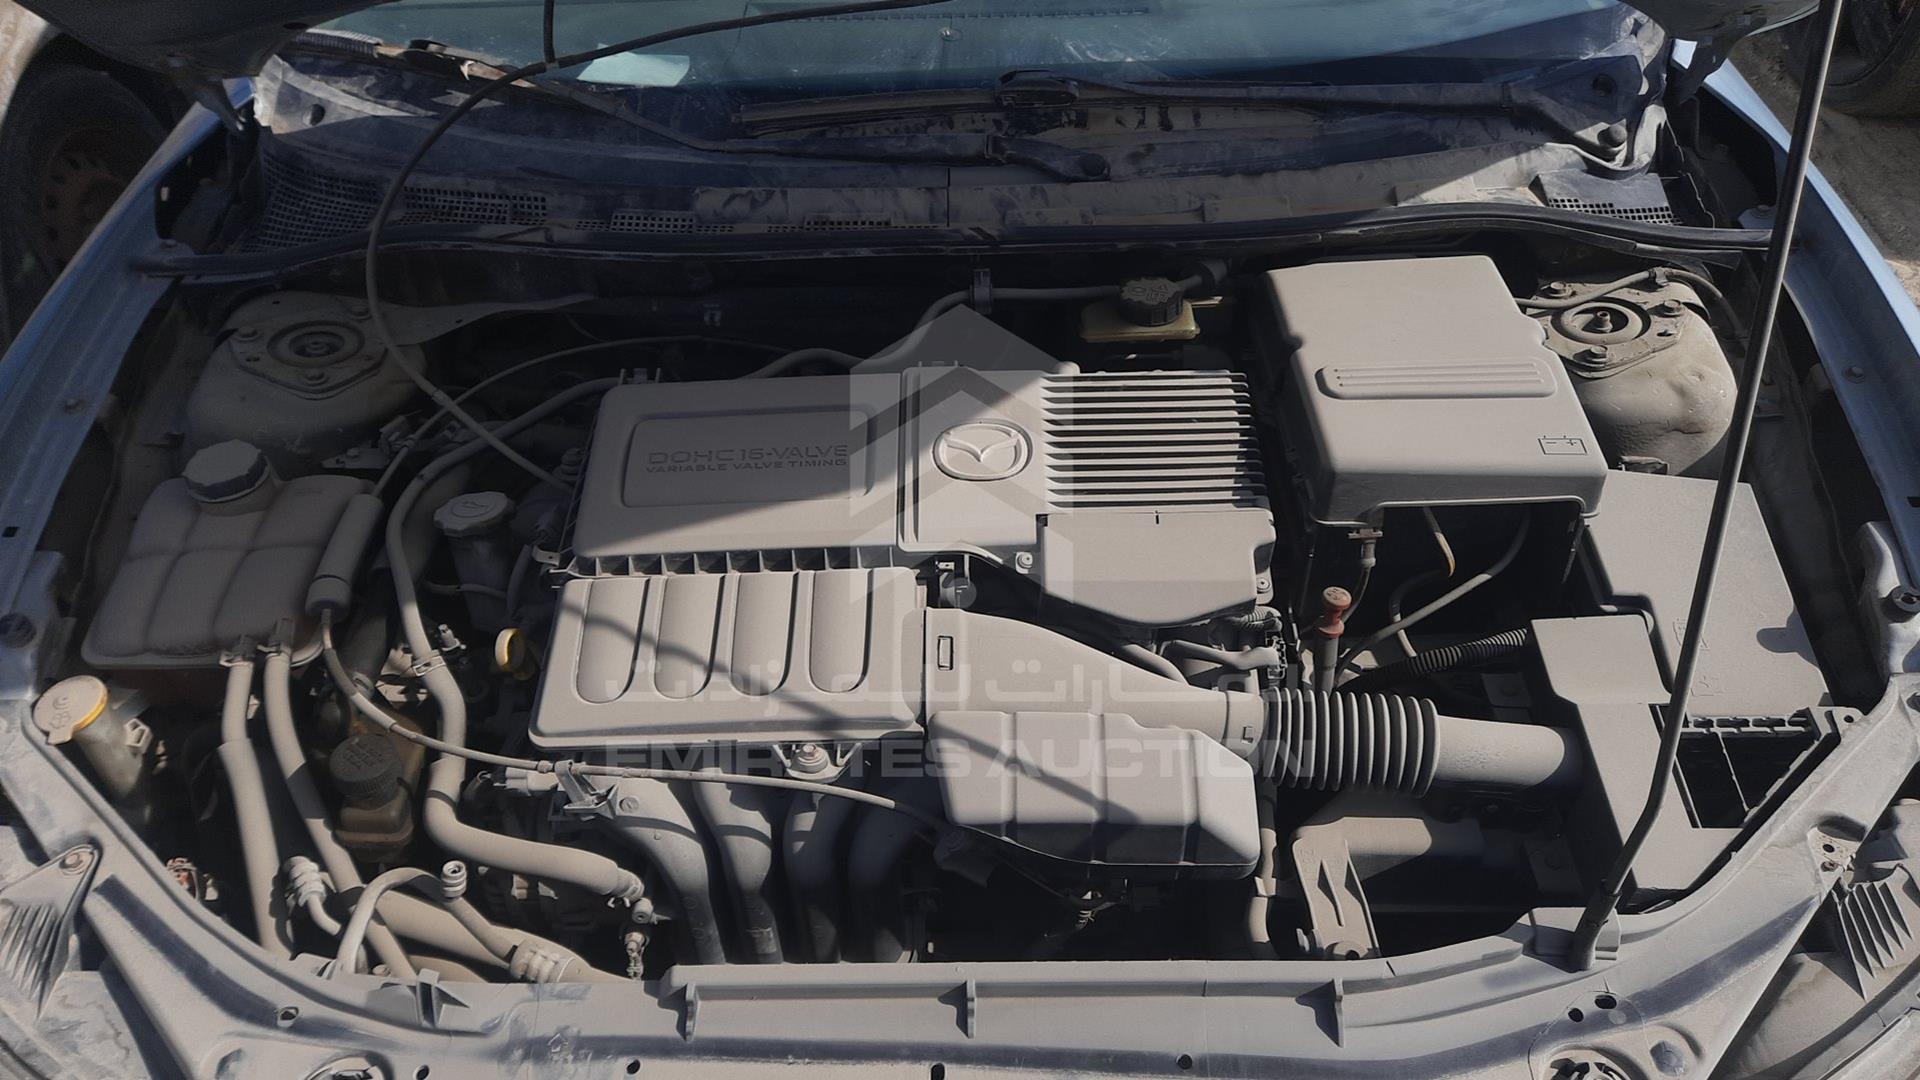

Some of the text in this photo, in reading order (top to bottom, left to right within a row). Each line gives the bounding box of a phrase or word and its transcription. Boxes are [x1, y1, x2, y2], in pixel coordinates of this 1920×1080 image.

[649, 449, 734, 464] DOHC
[646, 458, 848, 473] VARIABLE VALVE TIMING
